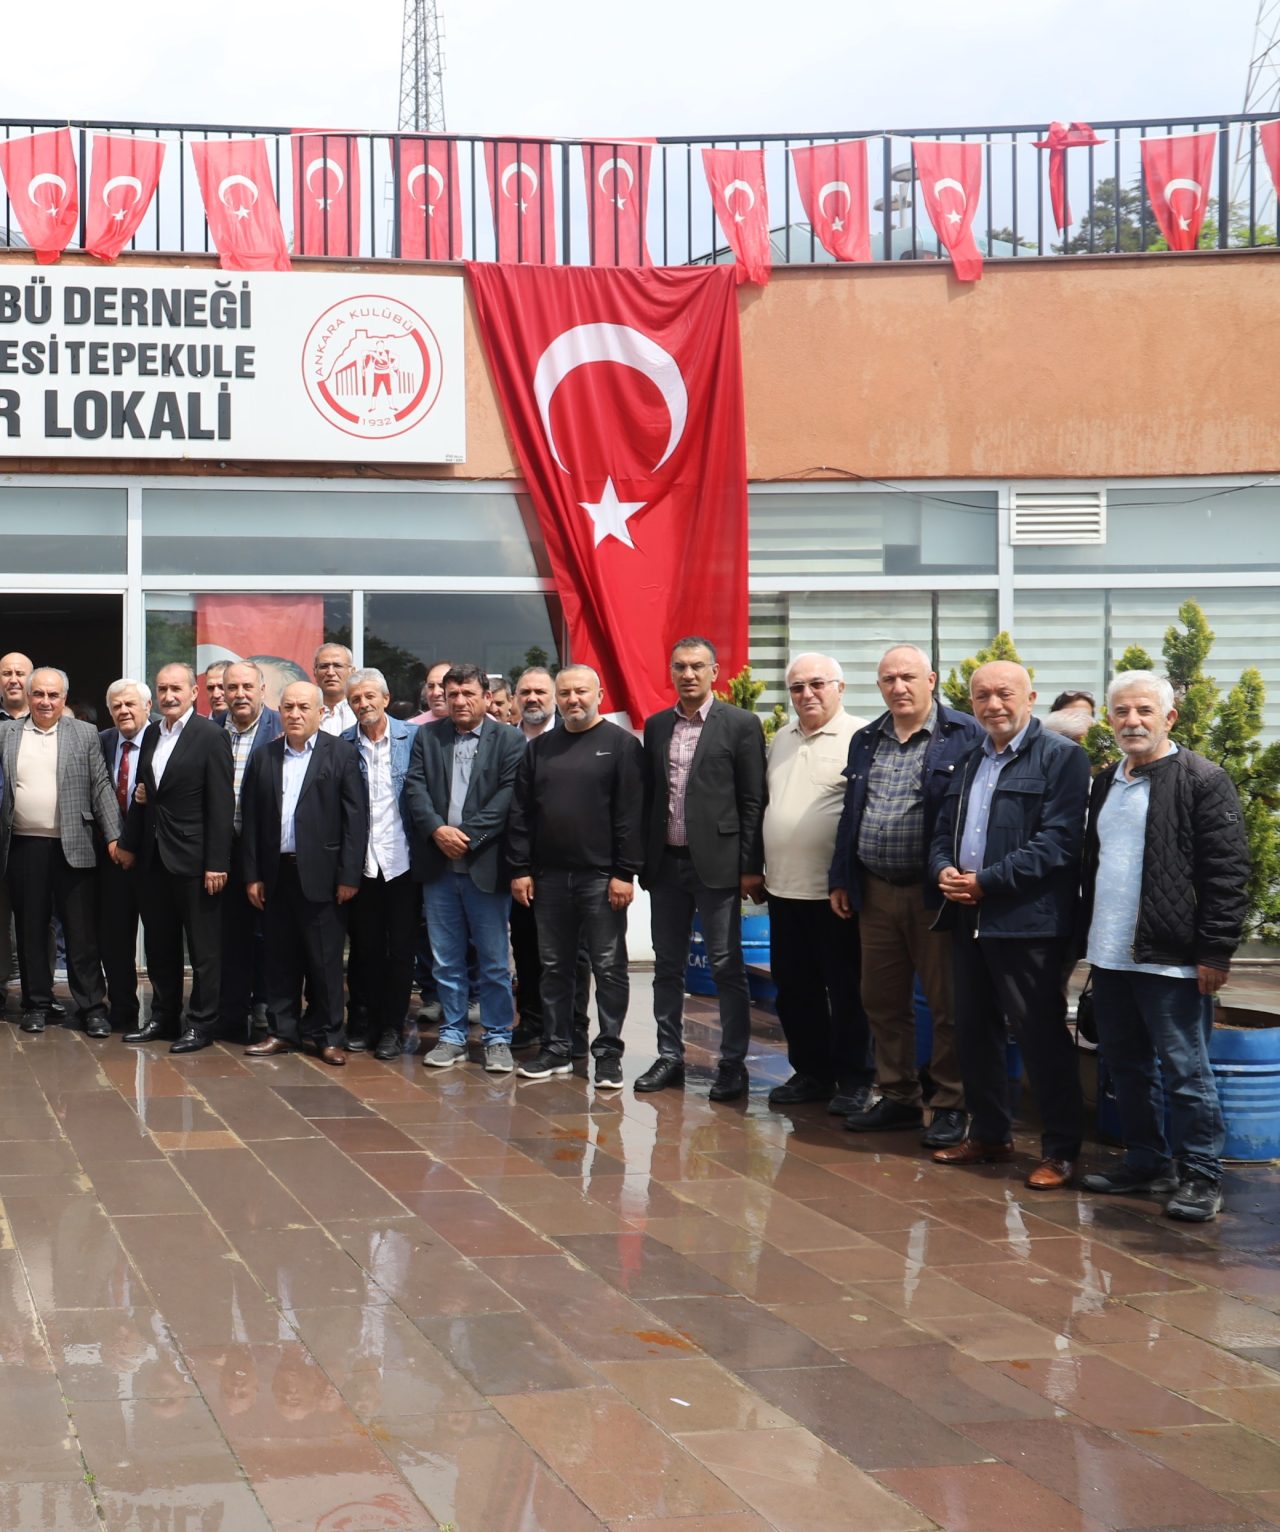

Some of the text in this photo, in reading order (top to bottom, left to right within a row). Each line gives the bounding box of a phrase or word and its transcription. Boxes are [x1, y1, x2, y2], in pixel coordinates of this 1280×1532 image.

[64, 280, 252, 329] DERNEĞİ
[65, 340, 256, 378] TEPEKULE
[315, 307, 414, 377] ANKARA KULÜBÜ
[44, 382, 232, 440] LOKALİ
[363, 417, 392, 427] 1932
[688, 953, 709, 969] CAF
